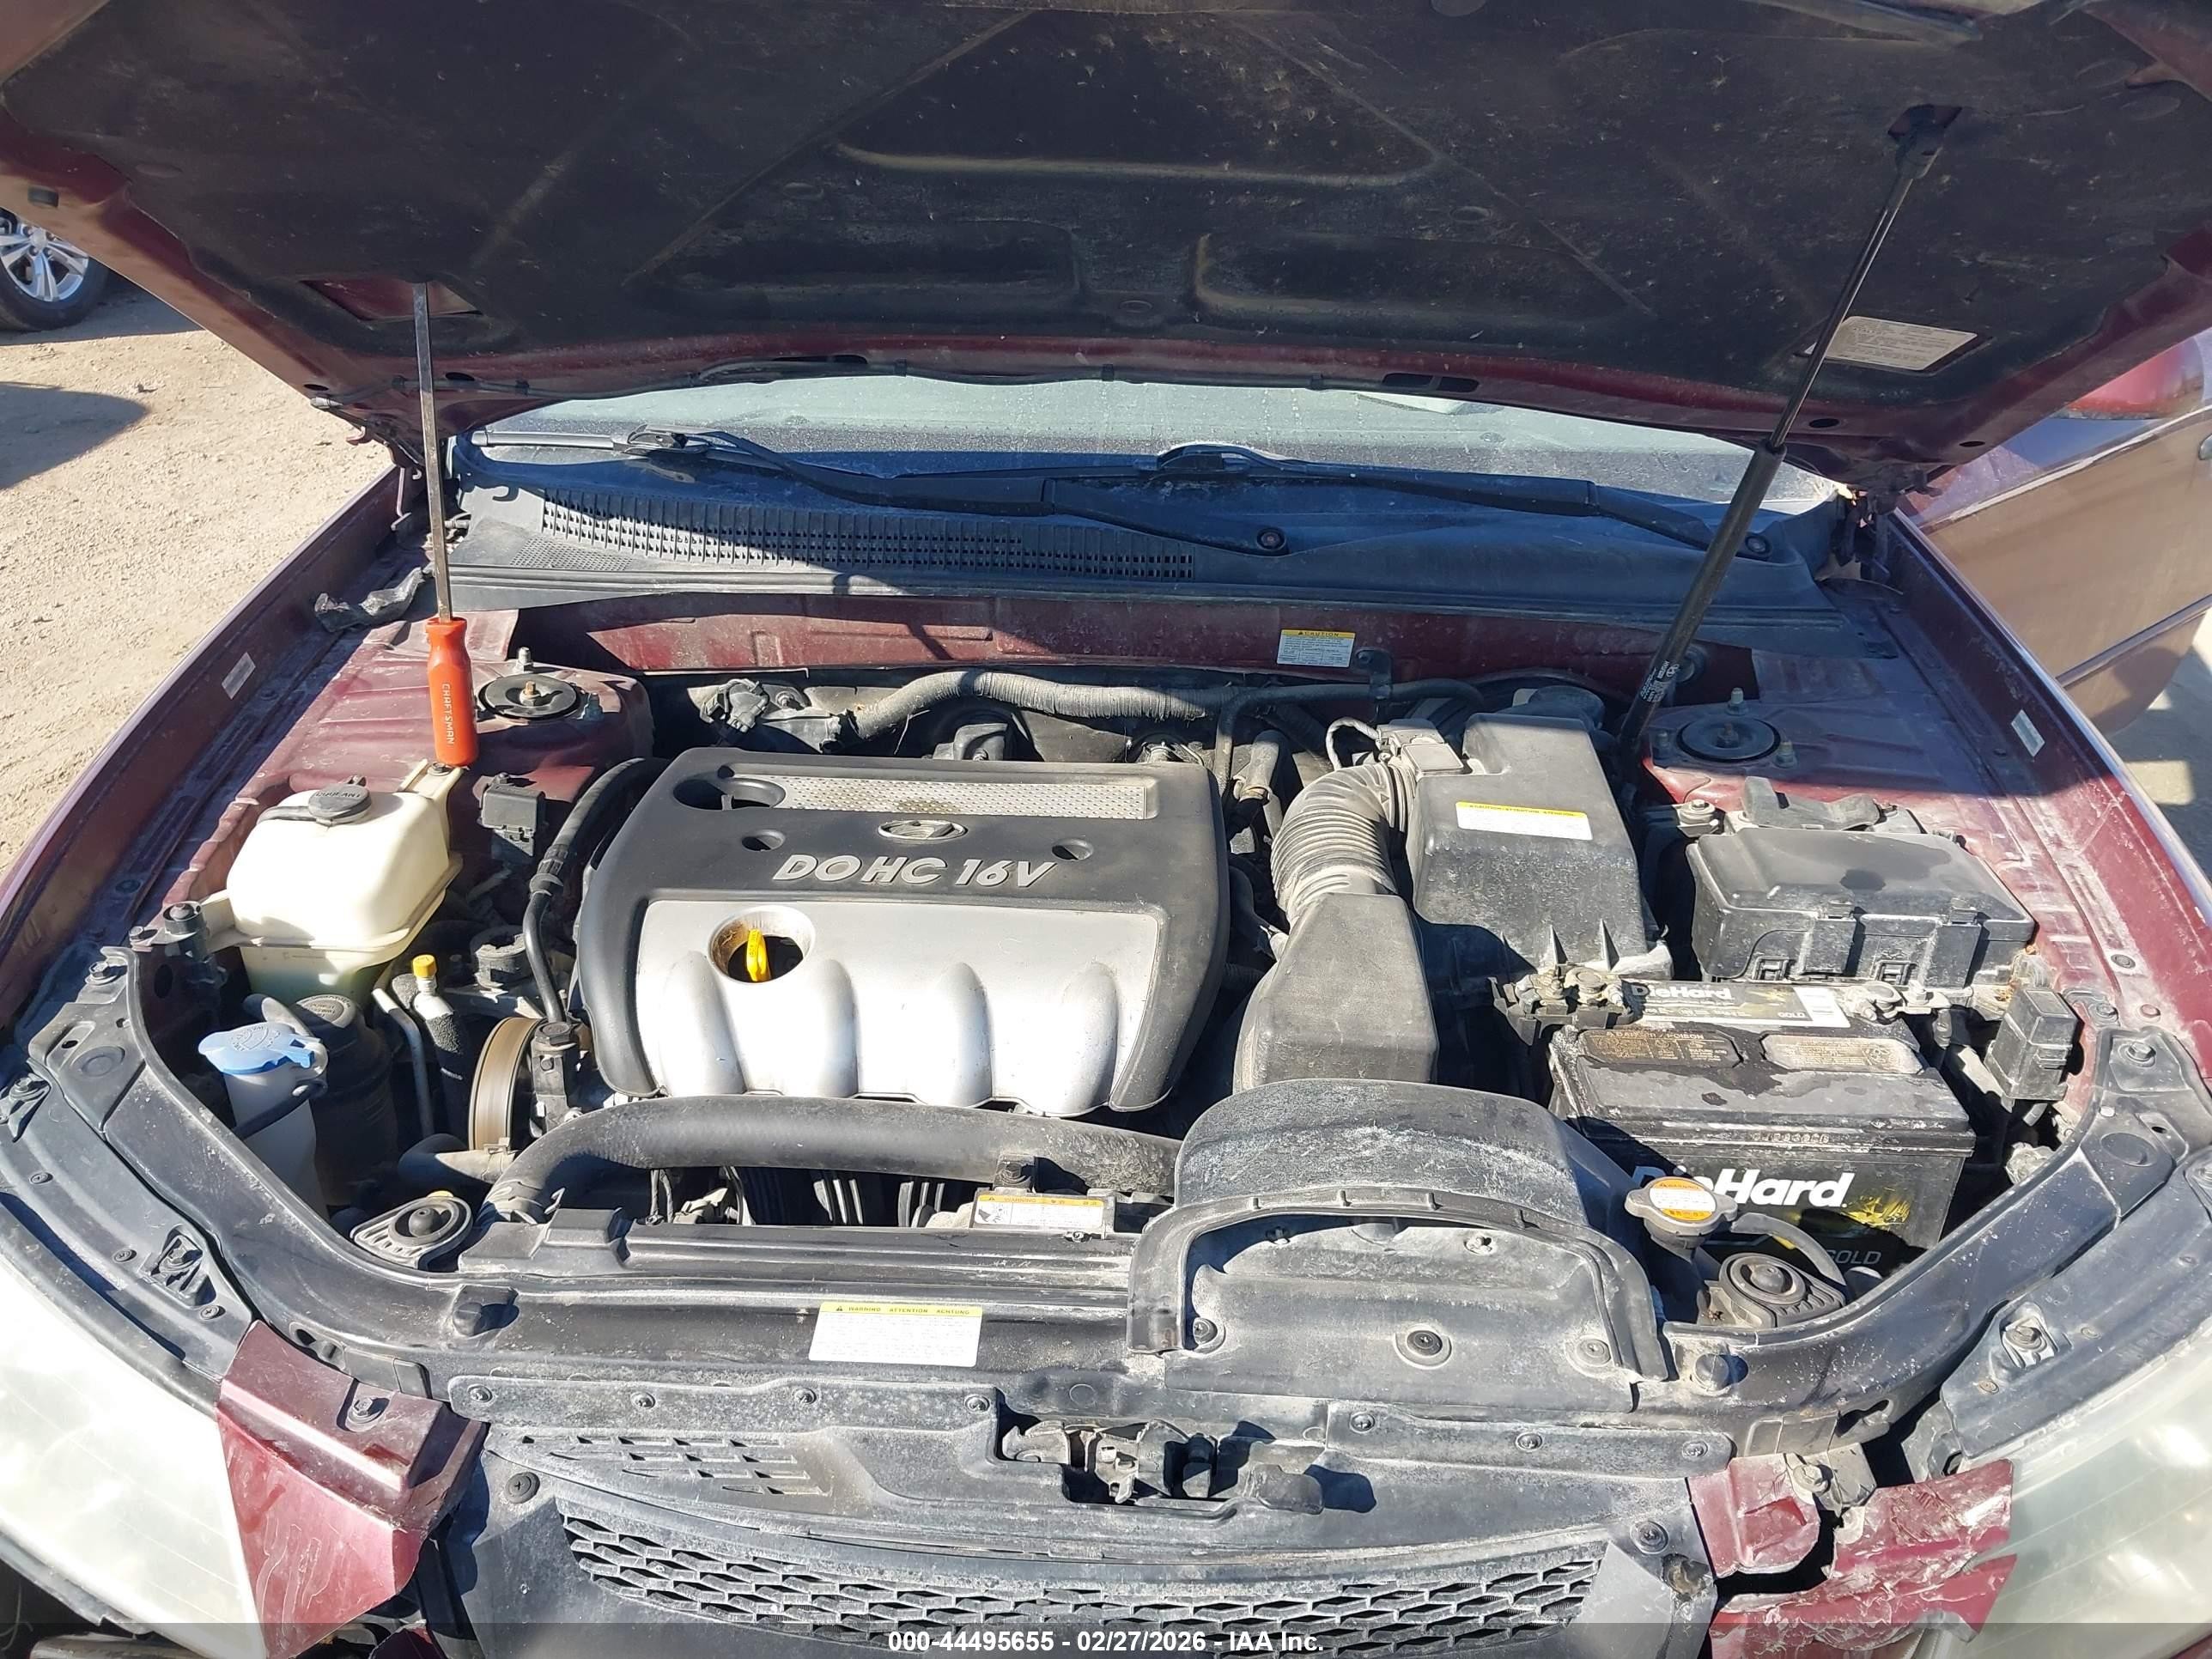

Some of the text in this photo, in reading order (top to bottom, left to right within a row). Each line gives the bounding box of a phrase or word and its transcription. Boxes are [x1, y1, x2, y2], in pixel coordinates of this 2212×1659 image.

[441, 683, 455, 745] CRAFTSMAN
[773, 854, 1058, 887] DOHC 16V
[1632, 982, 1732, 1000] DieHard
